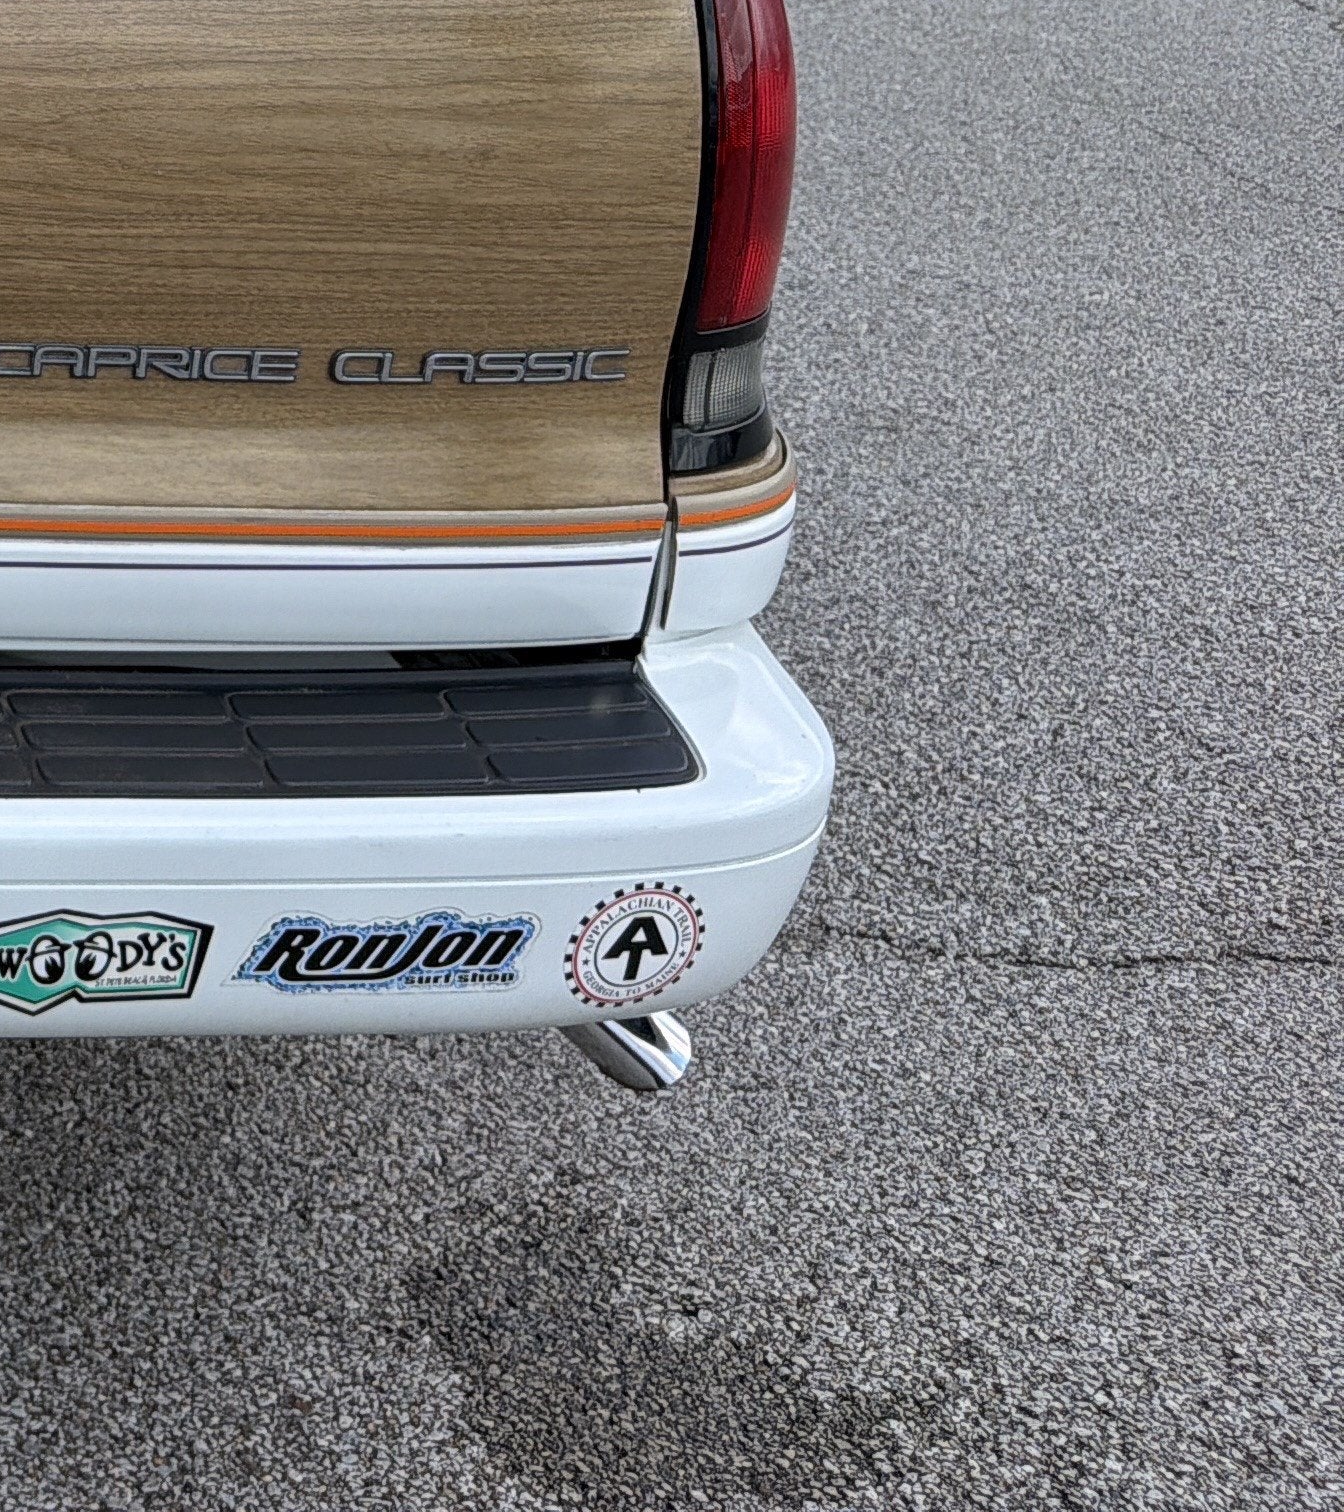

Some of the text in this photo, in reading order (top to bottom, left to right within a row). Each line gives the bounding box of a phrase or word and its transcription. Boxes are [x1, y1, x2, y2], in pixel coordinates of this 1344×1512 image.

[329, 348, 632, 385] CLASSIC
[582, 896, 692, 954] APPALACHIAN TRAIL
[405, 972, 514, 984] surf shop
[582, 962, 679, 998] GEORGIA TO MAINE
